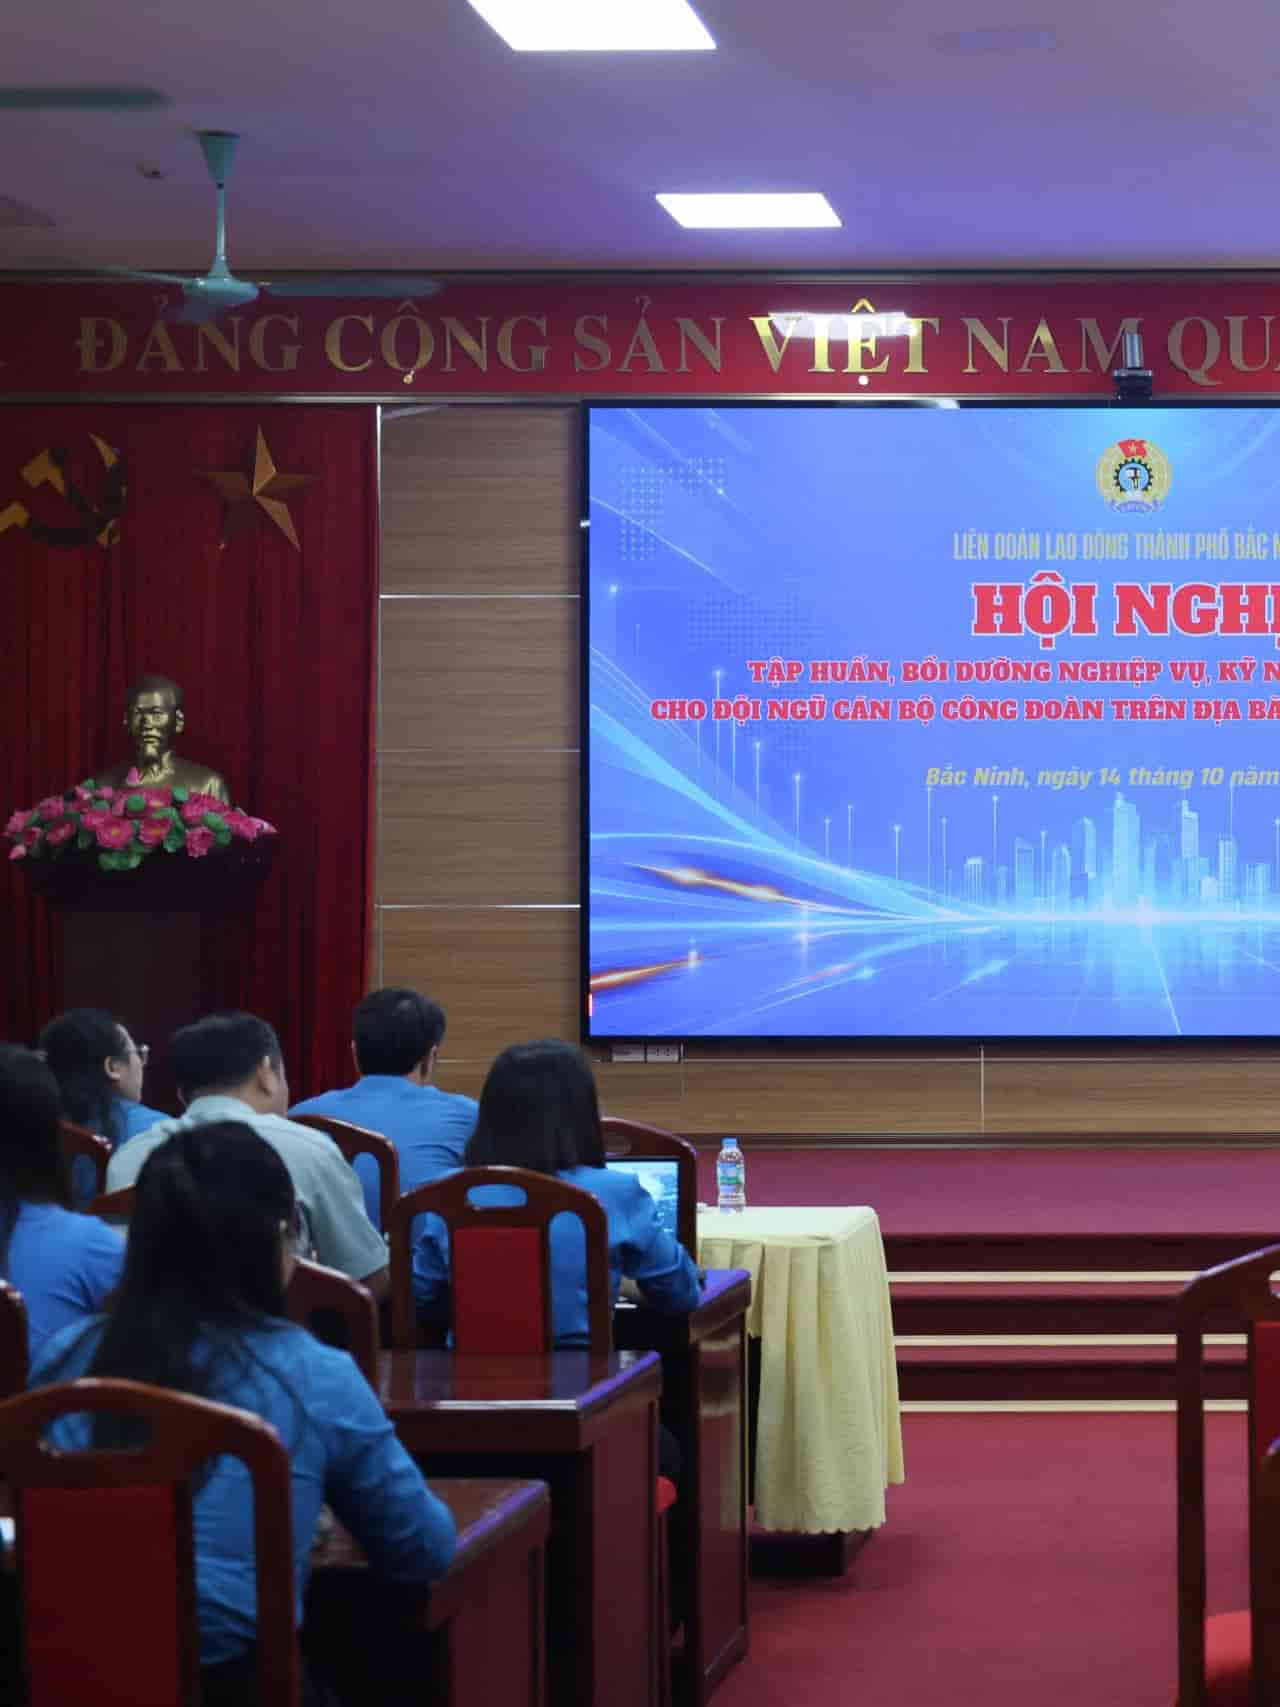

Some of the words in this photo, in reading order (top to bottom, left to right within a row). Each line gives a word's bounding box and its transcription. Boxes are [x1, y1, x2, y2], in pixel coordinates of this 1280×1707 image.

[75, 295, 303, 372] ĐẢNG
[324, 299, 550, 384] CỘNG
[573, 295, 728, 374] SẢN
[749, 298, 940, 386] VIỆT
[961, 317, 1145, 374] NAM
[953, 528, 988, 561] LIÊN
[1045, 532, 1077, 561] LAO
[1136, 527, 1190, 561] THÀNH
[971, 570, 1098, 650] HỘI
[748, 656, 803, 688] TẬP
[809, 653, 895, 688] HUẤN,
[955, 656, 1052, 682] DƯỠNG
[1058, 656, 1163, 688] NGHIỆP
[1168, 660, 1212, 688] VỤ,
[1217, 656, 1257, 682] KỸ
[651, 698, 706, 720] CHO
[712, 694, 762, 726] ĐỘI
[767, 694, 827, 720] NGŨ
[832, 695, 891, 720] CÁN
[898, 695, 936, 726] BỘ
[942, 695, 1018, 720] CÔNG
[1023, 696, 1105, 720] ĐOÀN
[1111, 695, 1187, 720] TRÊN
[1192, 698, 1242, 726] ĐỊA
[925, 763, 967, 785] Bắc
[973, 766, 1031, 789] Ninh,
[1037, 766, 1092, 790] ngày
[1099, 767, 1121, 785] 14
[1128, 766, 1194, 790] tháng
[1201, 768, 1225, 785] 10
[1231, 764, 1280, 785] năm
